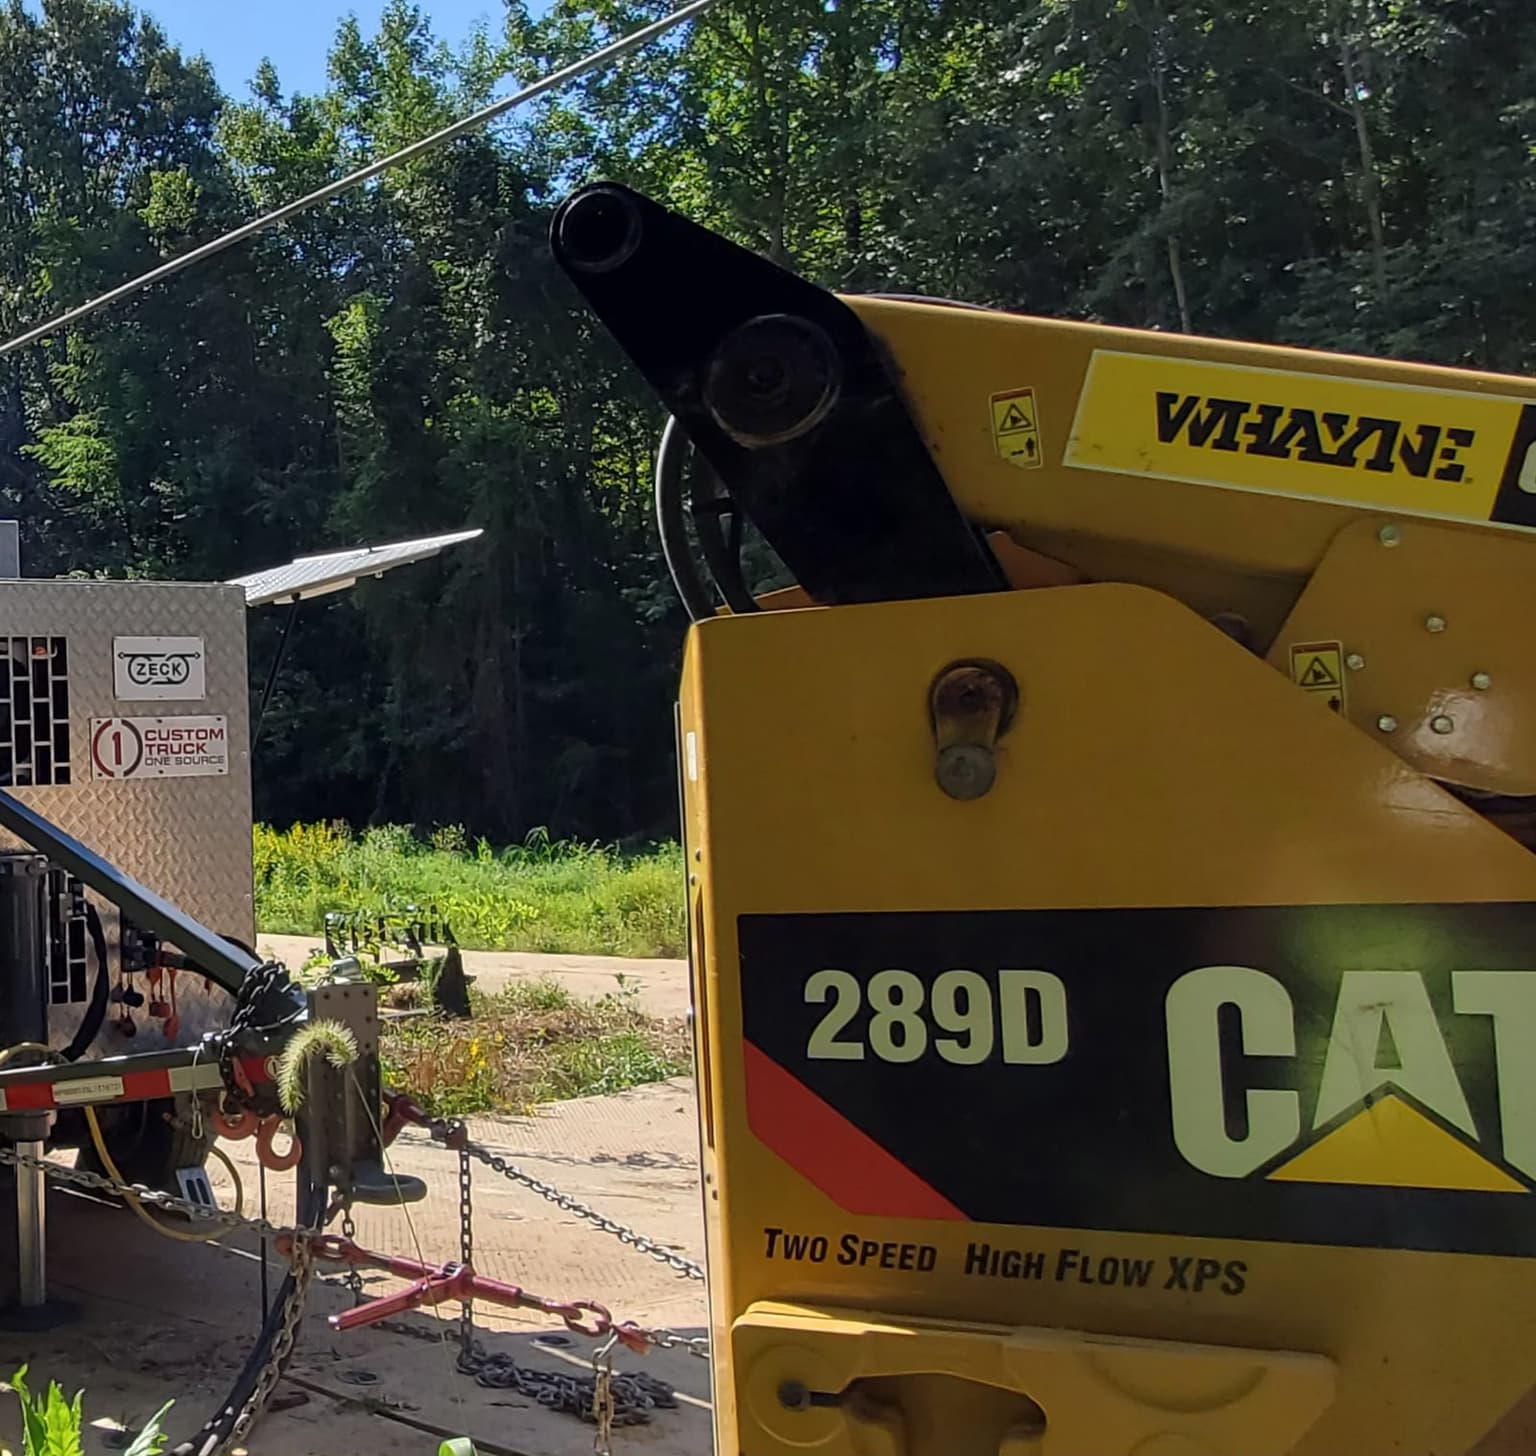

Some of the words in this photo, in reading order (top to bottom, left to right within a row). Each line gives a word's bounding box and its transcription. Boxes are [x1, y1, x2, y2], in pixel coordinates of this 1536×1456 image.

[1156, 391, 1476, 483] WHAYNE
[136, 662, 182, 676] ZECK
[144, 728, 224, 741] CUSTOM
[144, 743, 207, 756] TRUCK
[144, 757, 171, 766] ONE
[175, 756, 224, 766] SOURCE
[803, 969, 1069, 1065] 289D
[764, 1227, 829, 1264] TWO
[837, 1233, 938, 1273] SPEED
[964, 1242, 1045, 1281] HIGH
[1055, 1248, 1155, 1288] FLOW
[1164, 1256, 1249, 1297] XPS
